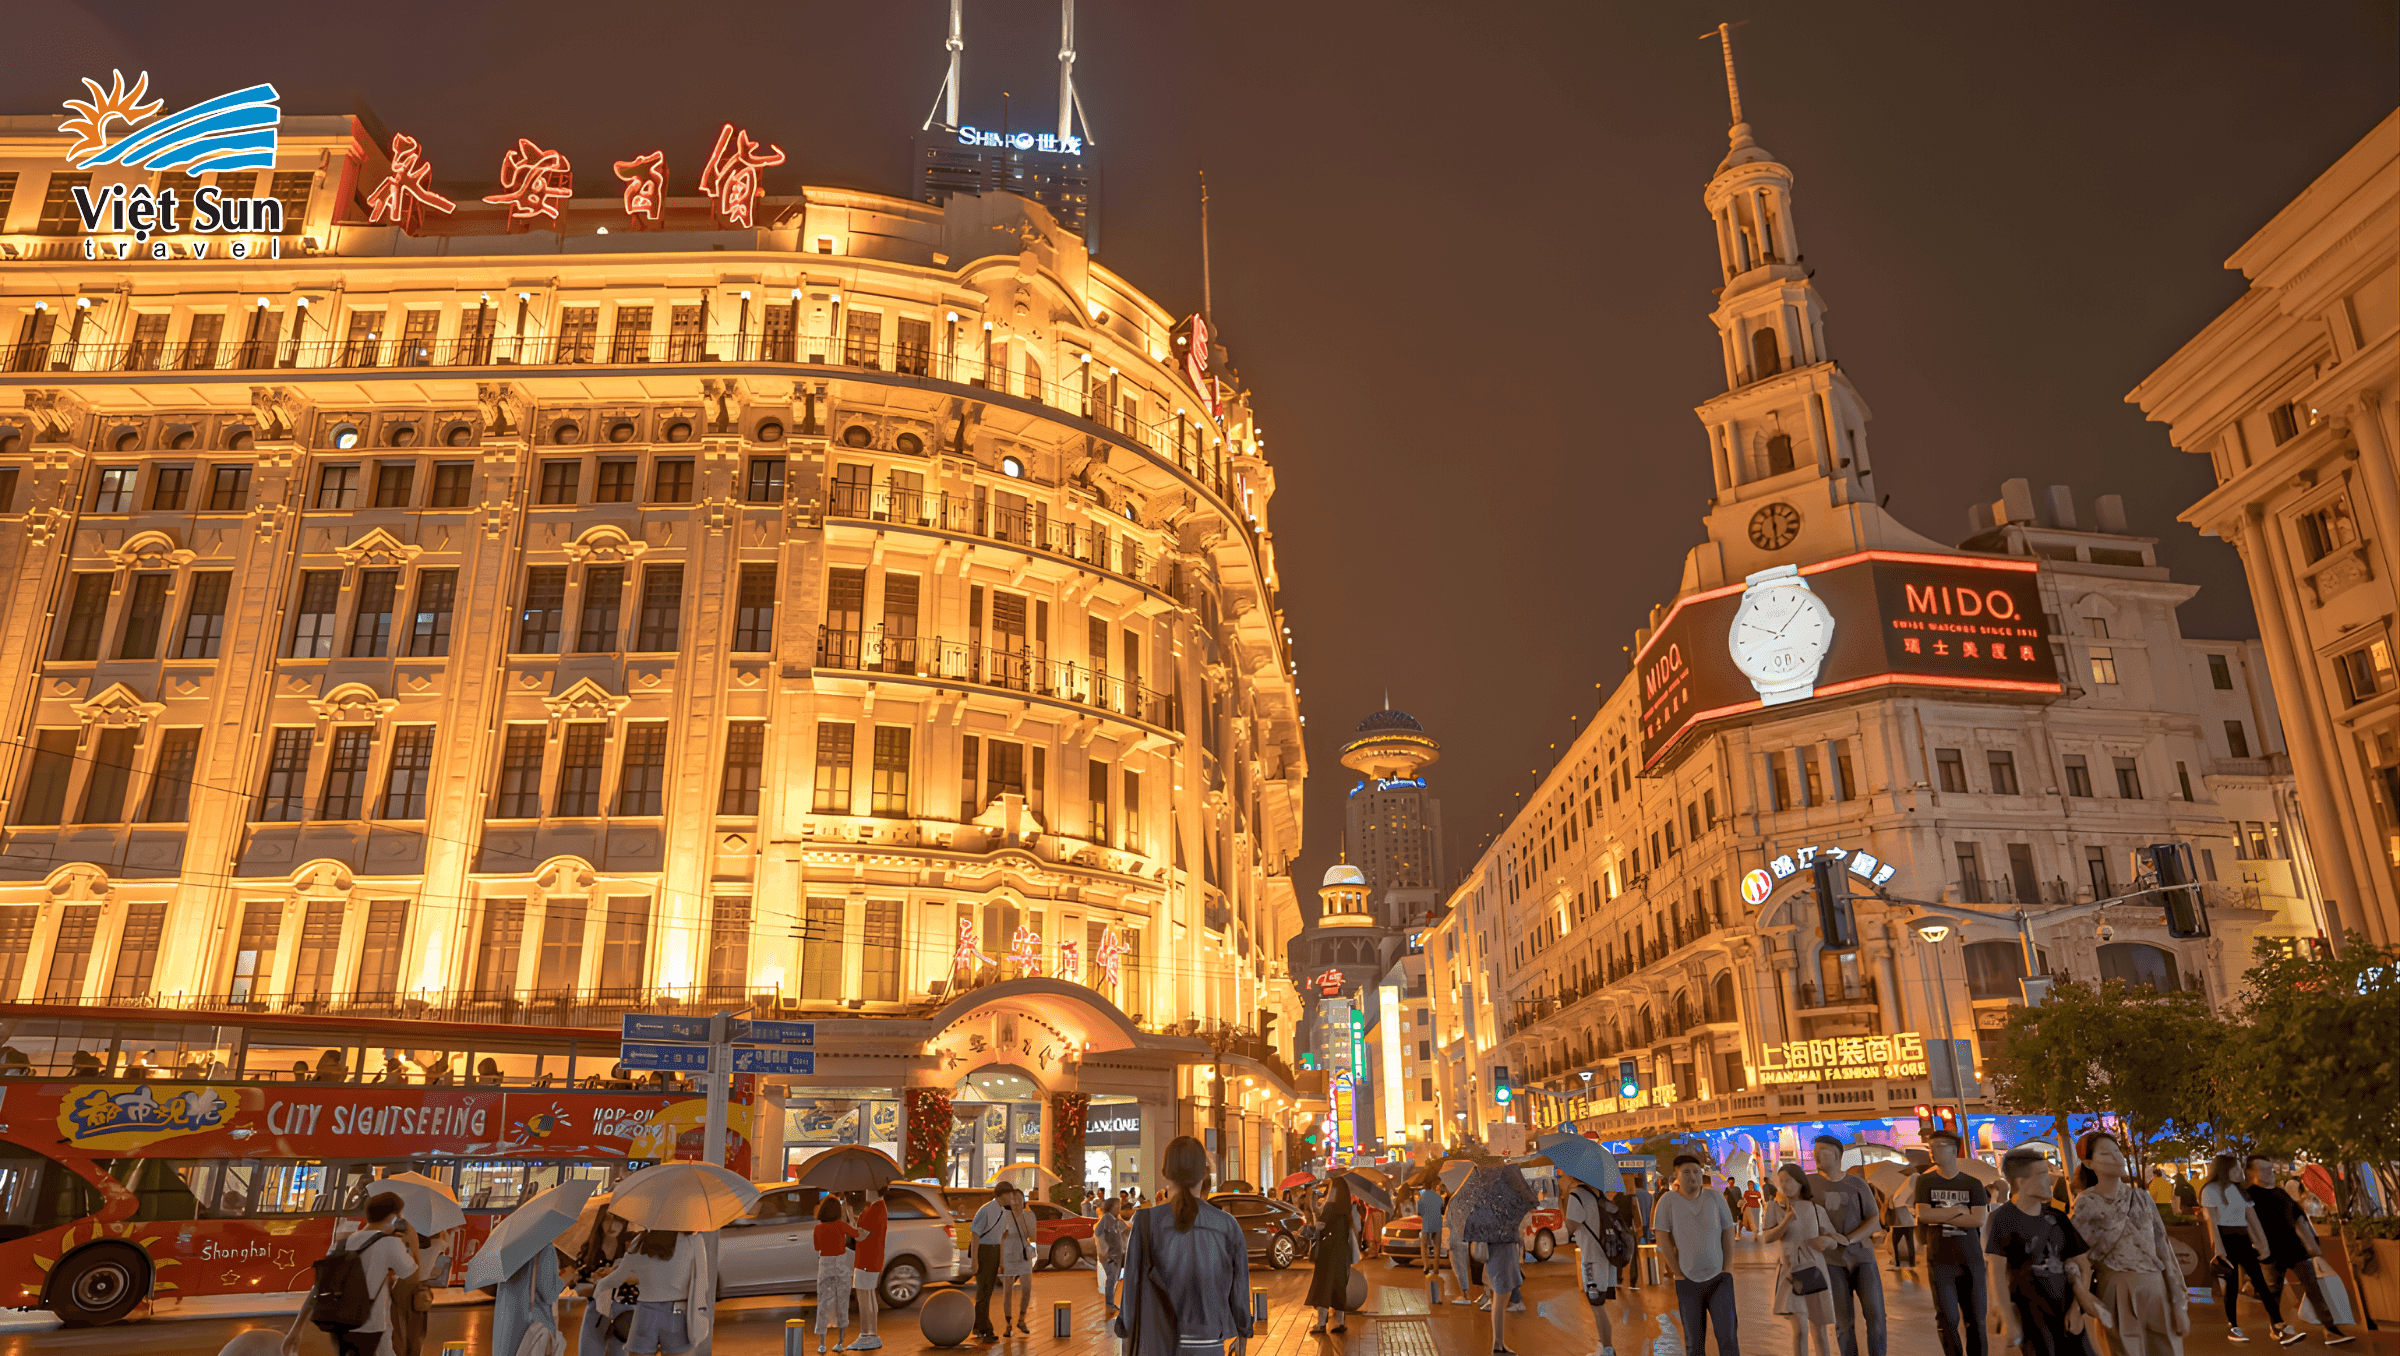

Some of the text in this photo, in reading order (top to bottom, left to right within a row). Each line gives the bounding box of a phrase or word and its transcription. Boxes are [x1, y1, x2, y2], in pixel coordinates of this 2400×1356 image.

[1759, 1031, 1925, 1071] 上海时装商店
[1759, 1061, 1928, 1085] SHANGHAI FASHION STORE
[266, 1096, 487, 1137] CITY SIGHTSEEING
[201, 1240, 272, 1263] Shanghai
